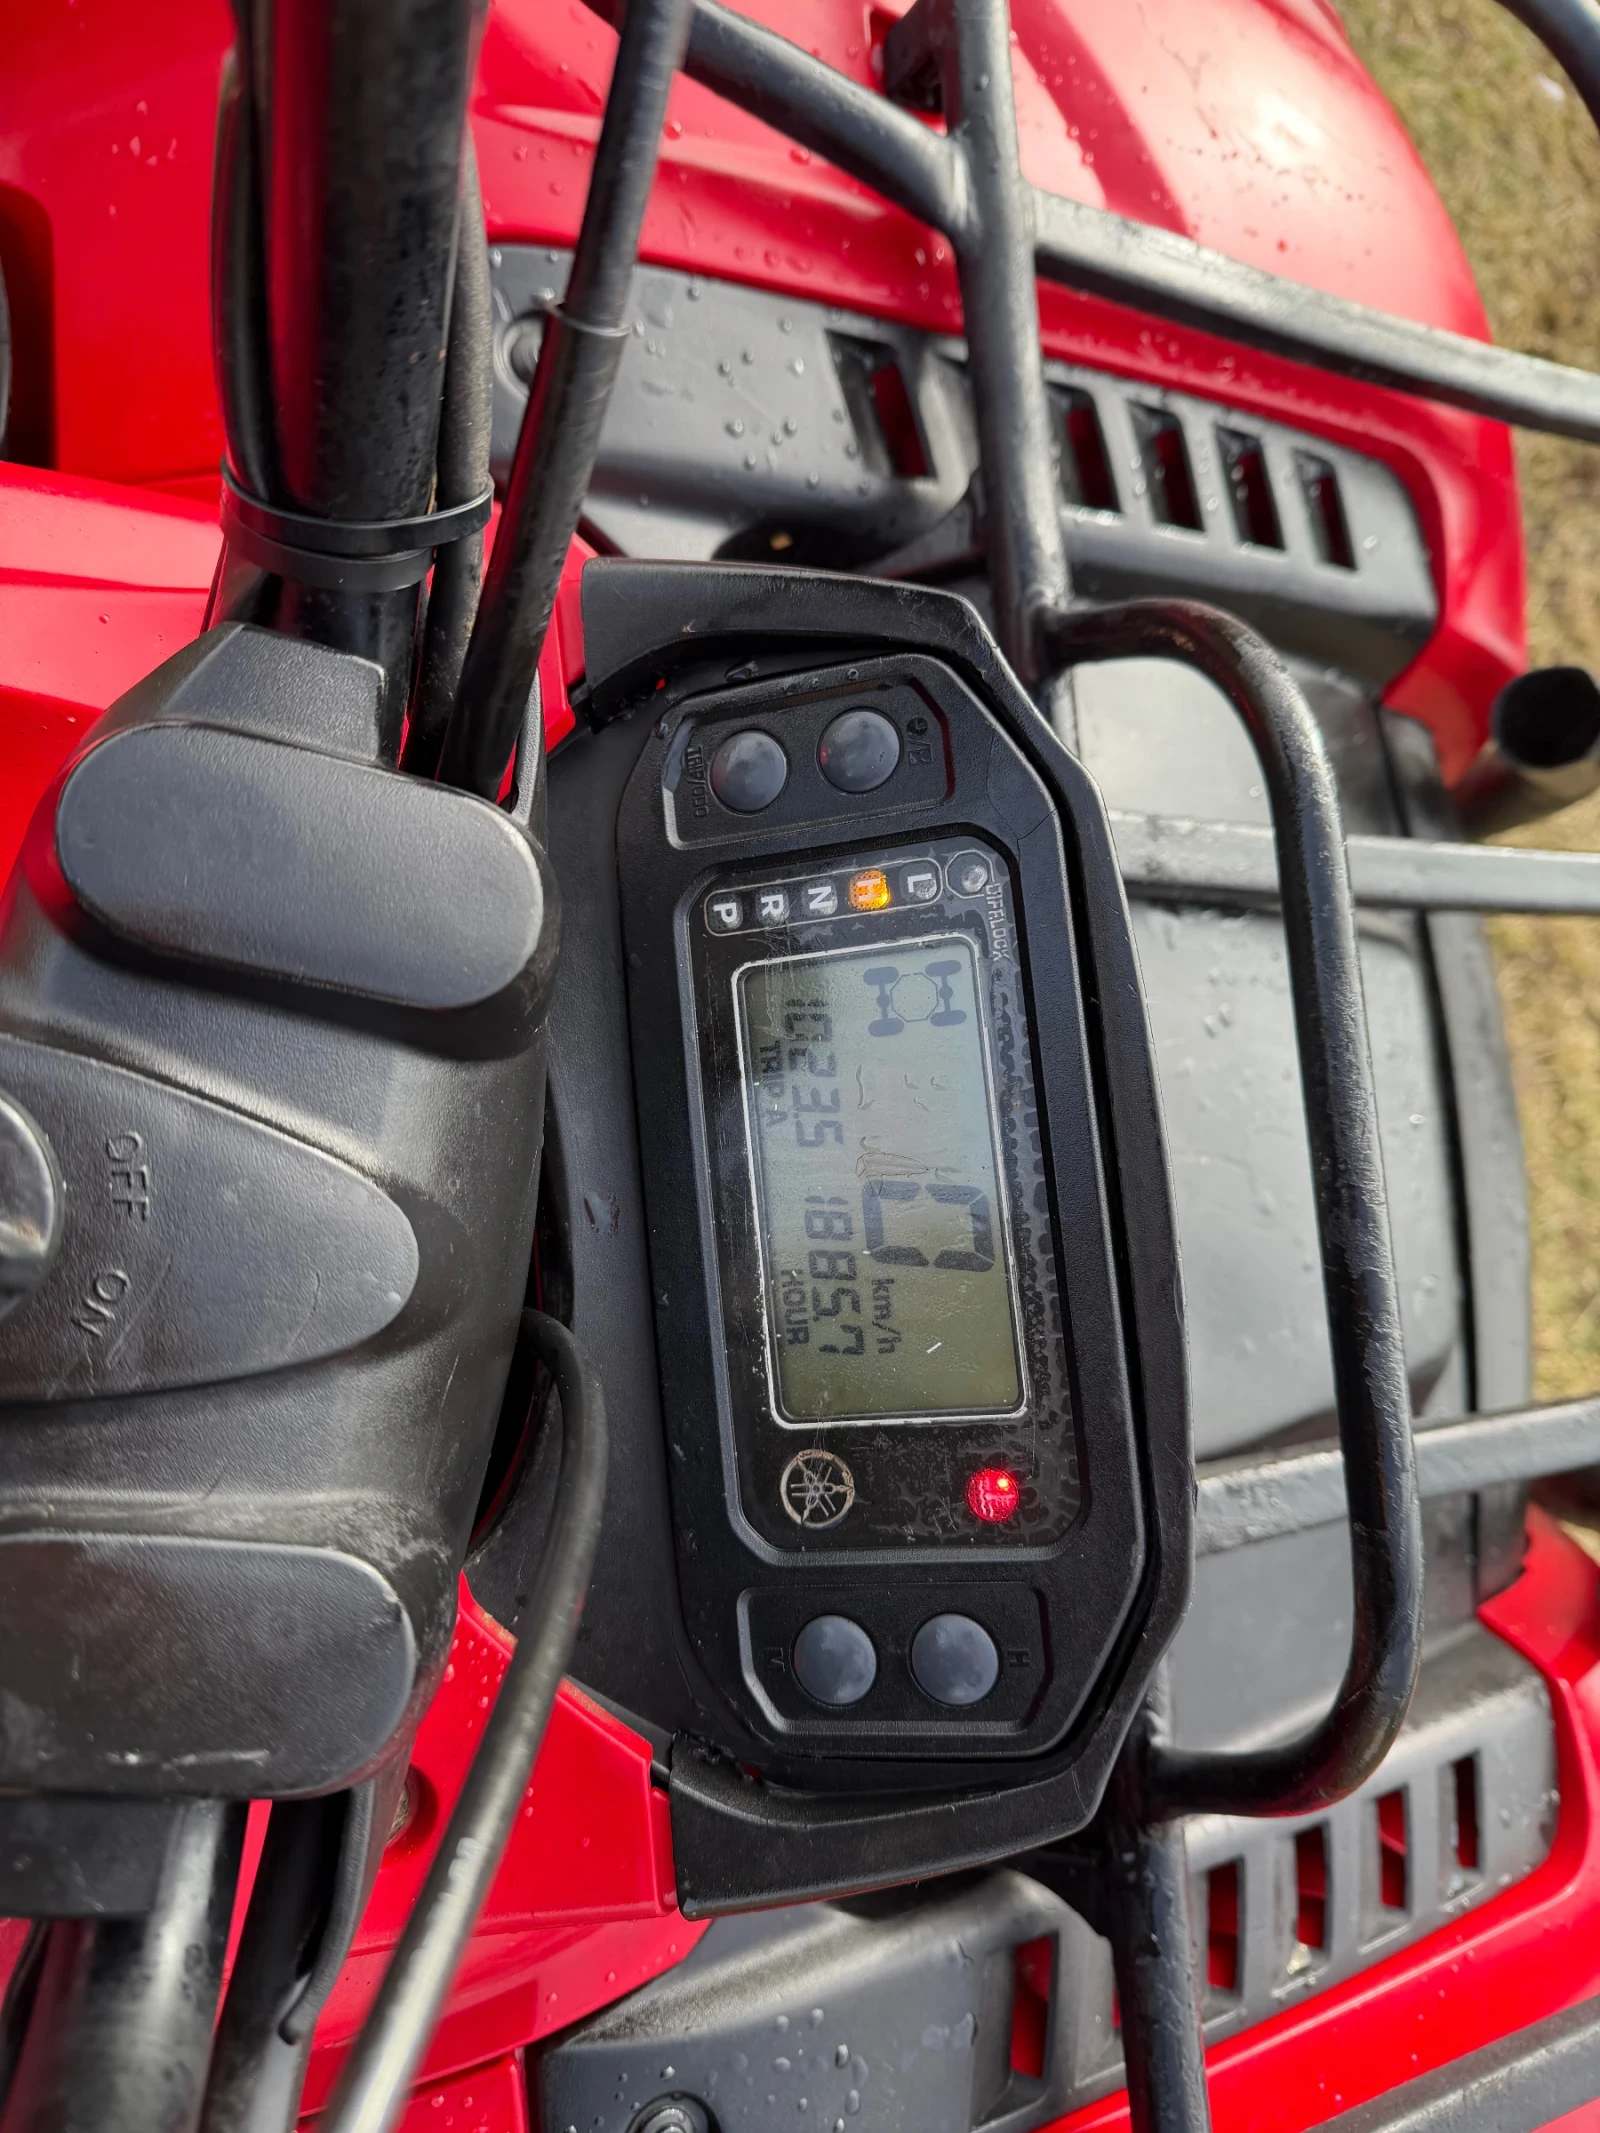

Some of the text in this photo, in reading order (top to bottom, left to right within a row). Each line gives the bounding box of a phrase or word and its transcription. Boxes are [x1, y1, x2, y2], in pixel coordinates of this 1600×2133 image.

[713, 902, 737, 924] P
[760, 894, 785, 917] R
[807, 885, 832, 910] N
[856, 878, 882, 901] H
[907, 873, 932, 893] L
[760, 1040, 788, 1127] TRIP A
[785, 999, 844, 1147] 1023.5
[106, 1130, 149, 1222] OFF
[804, 1195, 865, 1355] 1885.7
[862, 1180, 995, 1354] 0 km/h
[71, 1269, 131, 1338] ON
[780, 1269, 810, 1345] HOUR
[1007, 1650, 1031, 1667] H
